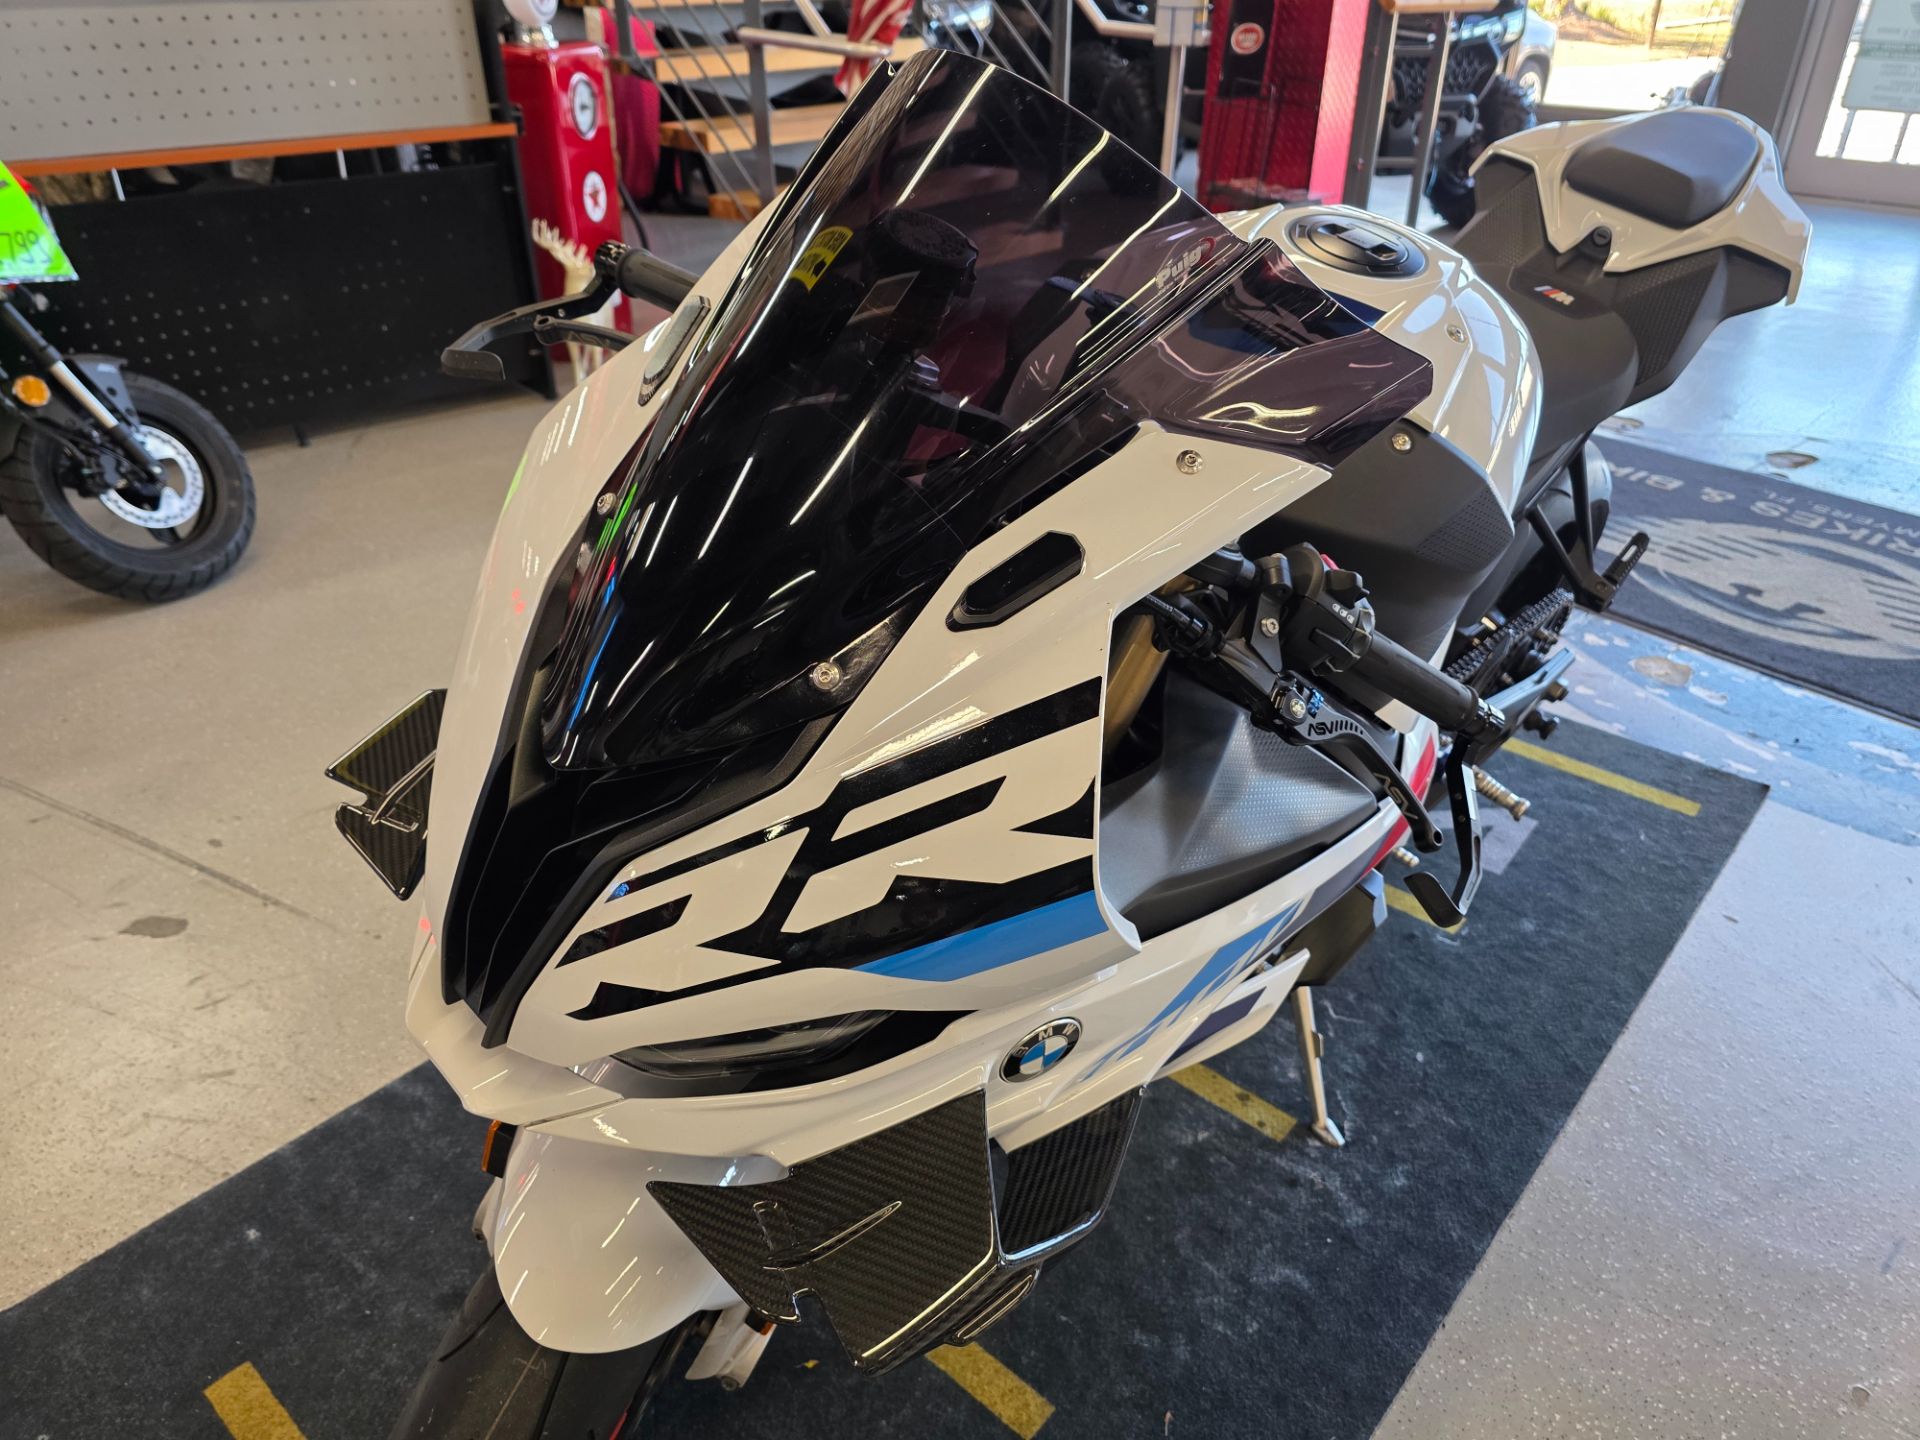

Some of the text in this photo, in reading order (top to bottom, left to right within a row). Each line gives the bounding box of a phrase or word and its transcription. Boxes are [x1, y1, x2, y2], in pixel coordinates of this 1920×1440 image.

[1155, 243, 1202, 291] Puig
[1700, 486, 1737, 503] &
[1307, 720, 1335, 737] ASV
[1010, 1021, 1079, 1060] BMW
